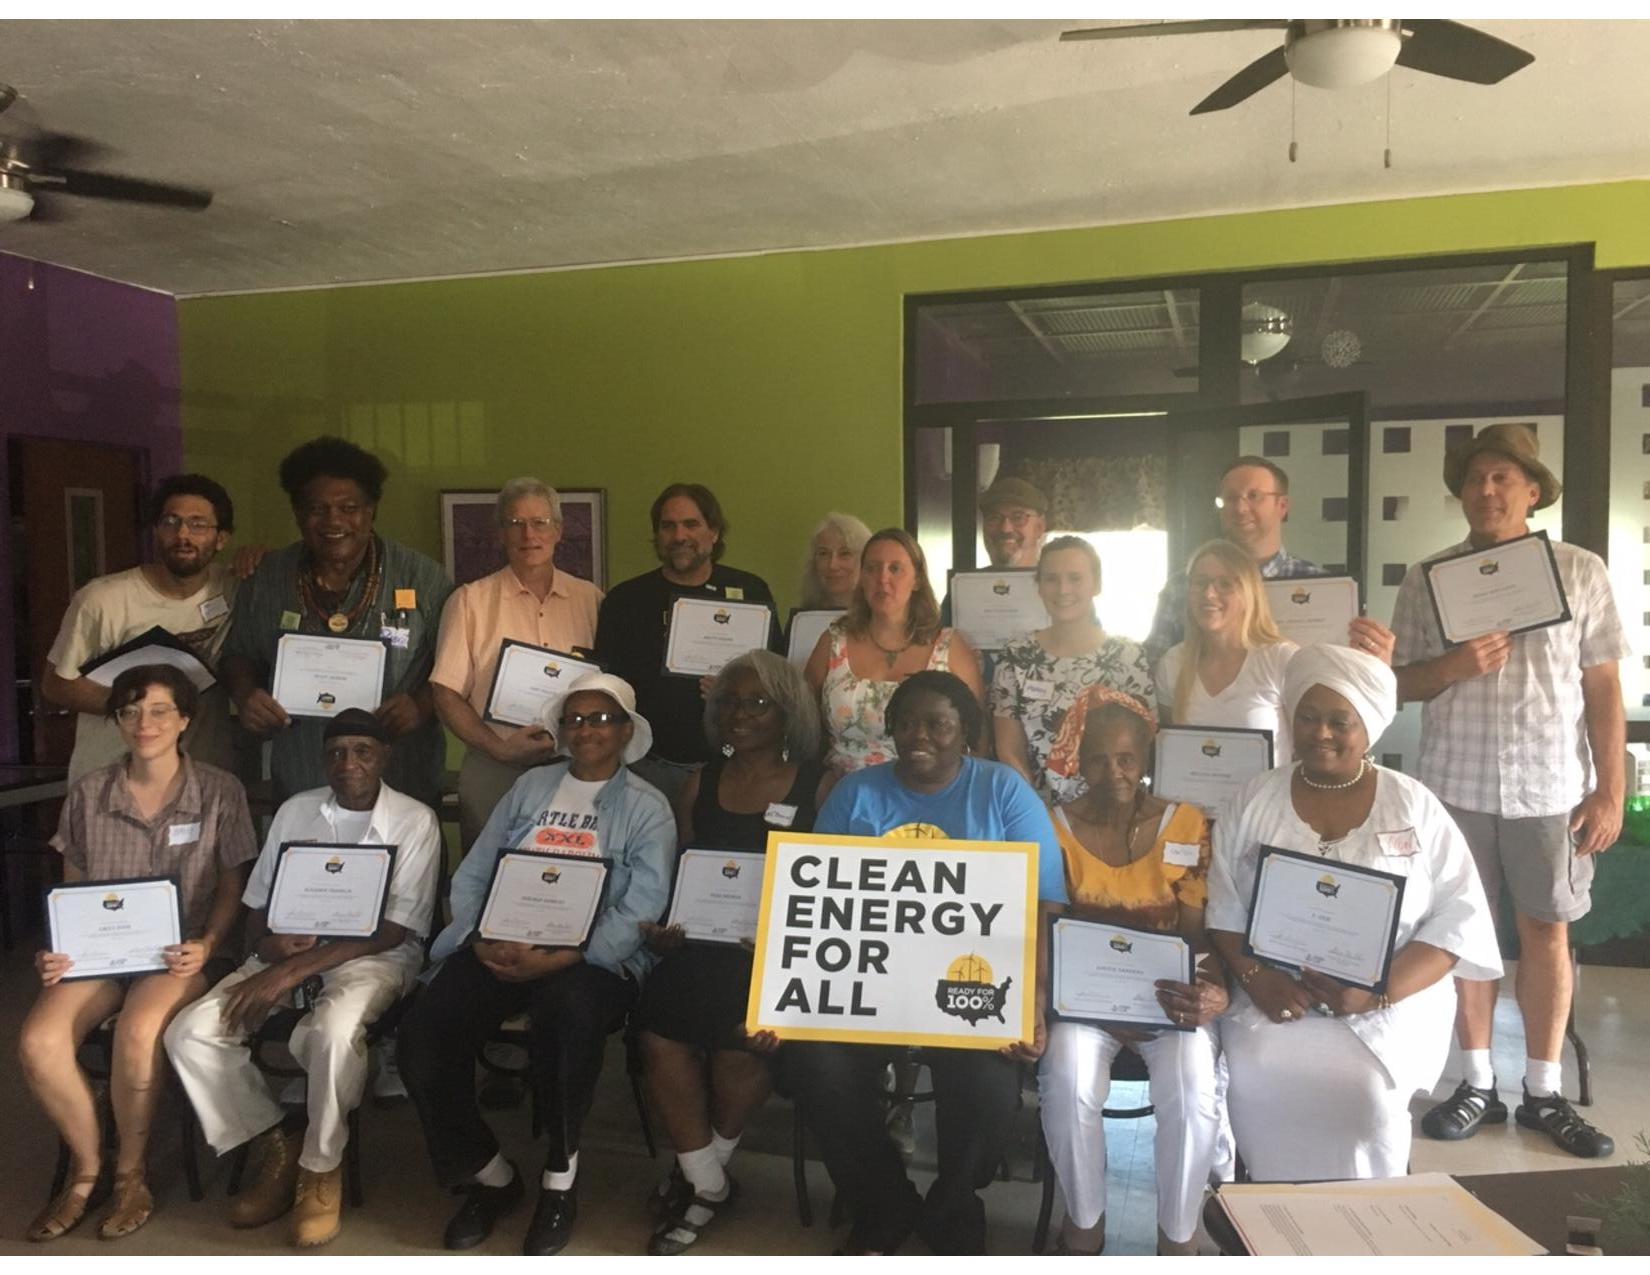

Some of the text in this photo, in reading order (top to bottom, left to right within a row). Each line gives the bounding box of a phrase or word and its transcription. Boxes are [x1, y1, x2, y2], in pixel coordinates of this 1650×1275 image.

[790, 855, 967, 895] CLEAN
[785, 895, 1004, 936] ENERGY
[781, 935, 890, 974] FOR
[774, 977, 877, 1016] ALL
[947, 987, 995, 996] READY FOR
[947, 995, 995, 1010] 100%
